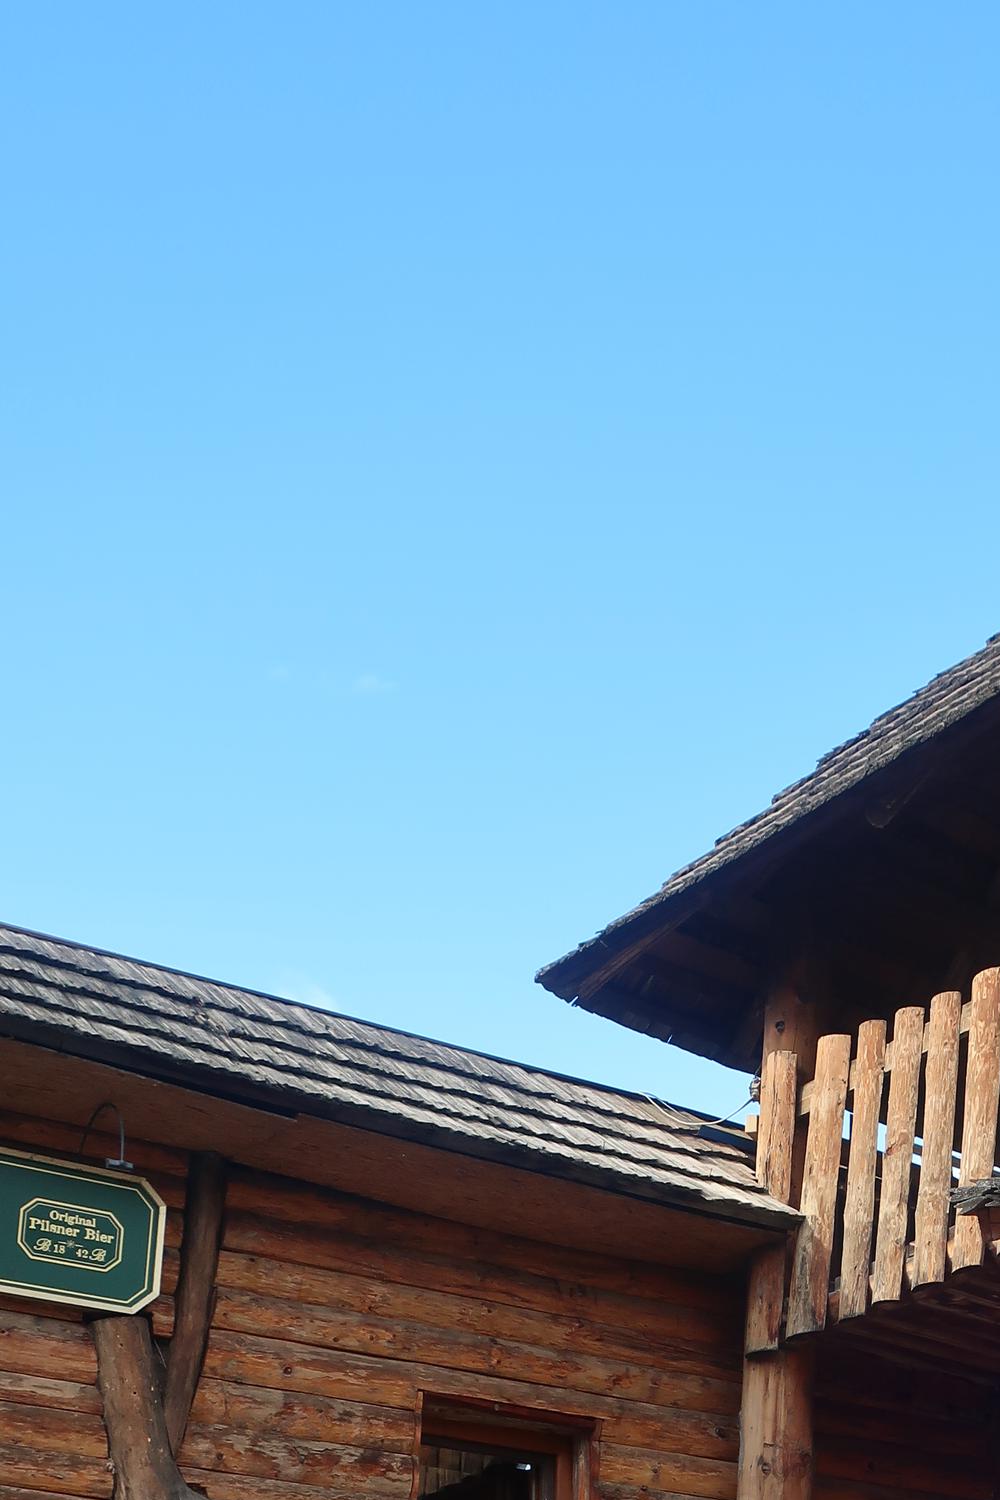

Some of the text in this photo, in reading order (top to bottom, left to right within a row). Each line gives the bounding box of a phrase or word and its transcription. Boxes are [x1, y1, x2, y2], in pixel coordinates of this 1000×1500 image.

[49, 1210, 97, 1228] Original
[28, 1217, 115, 1244] Pilsner Bier
